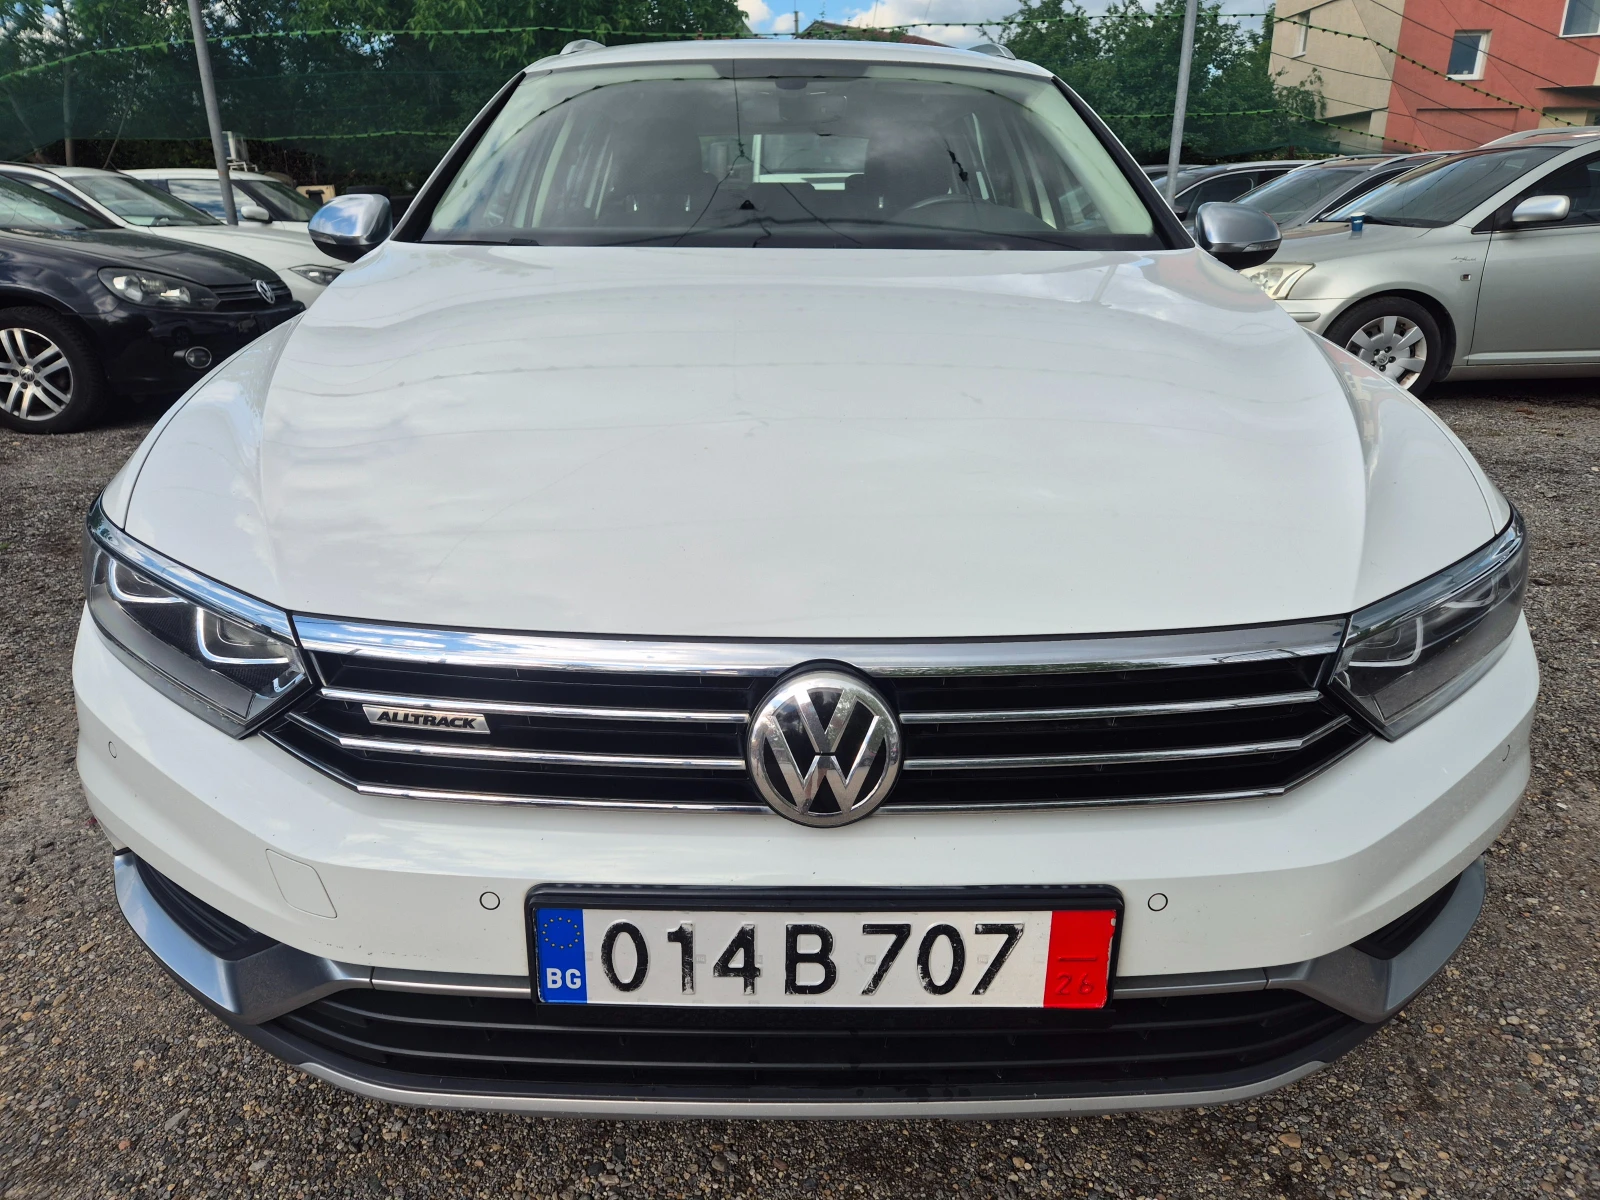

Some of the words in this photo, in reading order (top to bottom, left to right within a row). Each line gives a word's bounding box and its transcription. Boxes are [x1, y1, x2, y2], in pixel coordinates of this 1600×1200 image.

[376, 711, 477, 729] ALLTRACK
[762, 685, 889, 815] VW
[601, 921, 761, 995] 014
[785, 923, 837, 995] B
[861, 923, 1025, 995] 707
[546, 968, 582, 989] BG
[1055, 973, 1095, 995] 26
